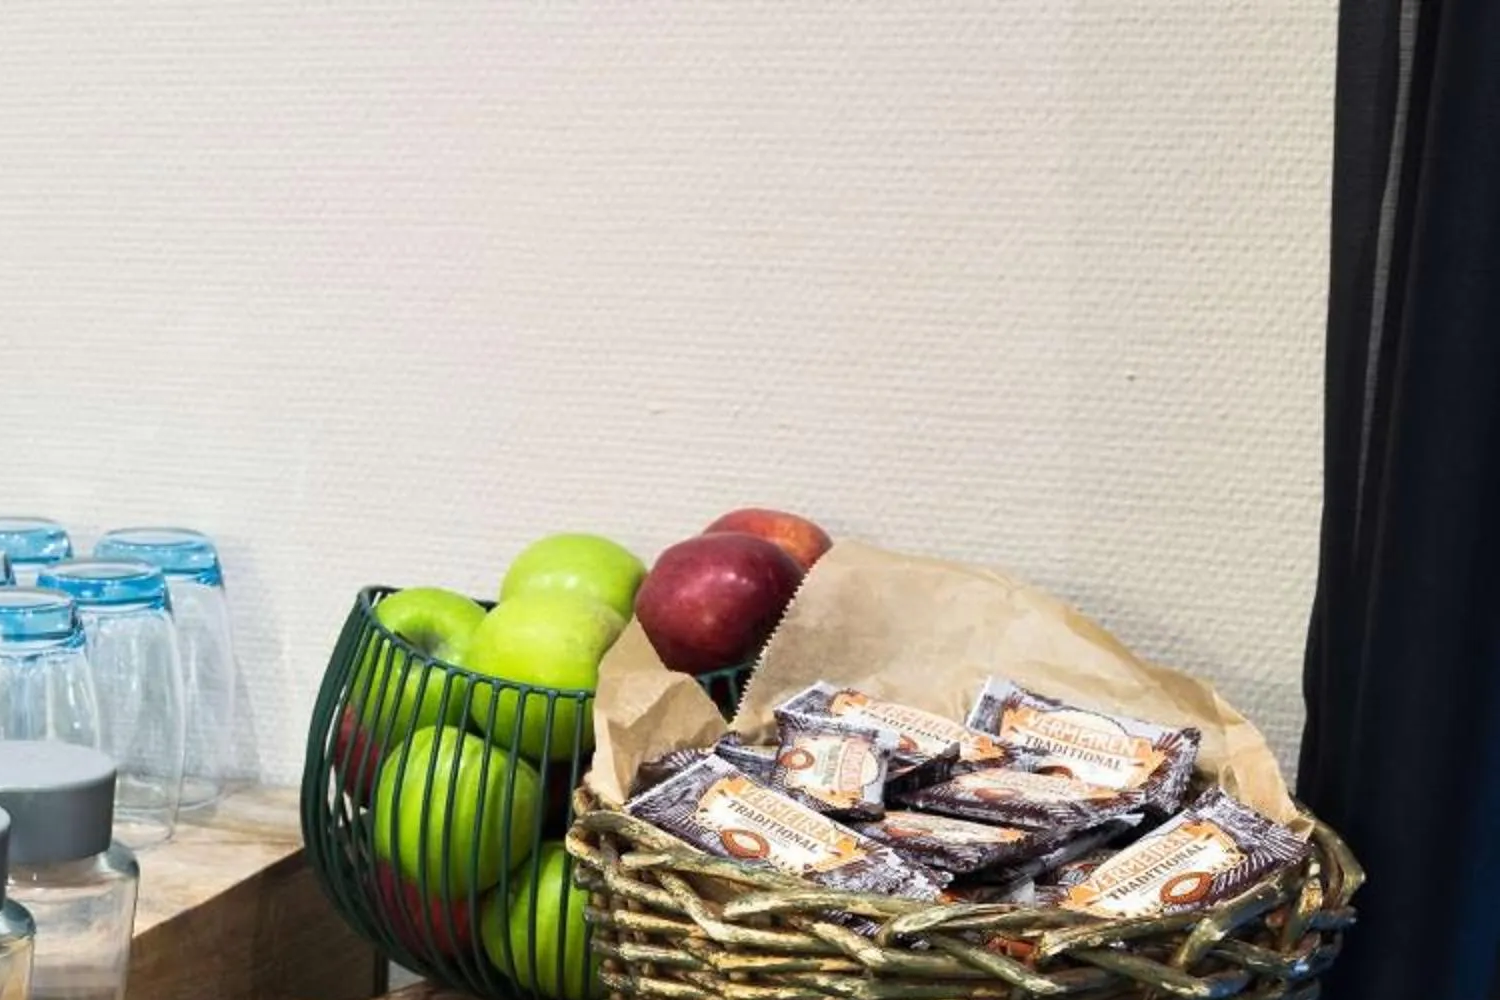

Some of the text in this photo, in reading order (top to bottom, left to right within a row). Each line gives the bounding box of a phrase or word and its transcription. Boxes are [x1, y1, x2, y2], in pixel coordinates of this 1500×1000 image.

[1024, 735, 1123, 770] TRADITIONAL
[728, 801, 821, 853] TRADITIONAL
[1106, 843, 1207, 900] TRADITIONAL
